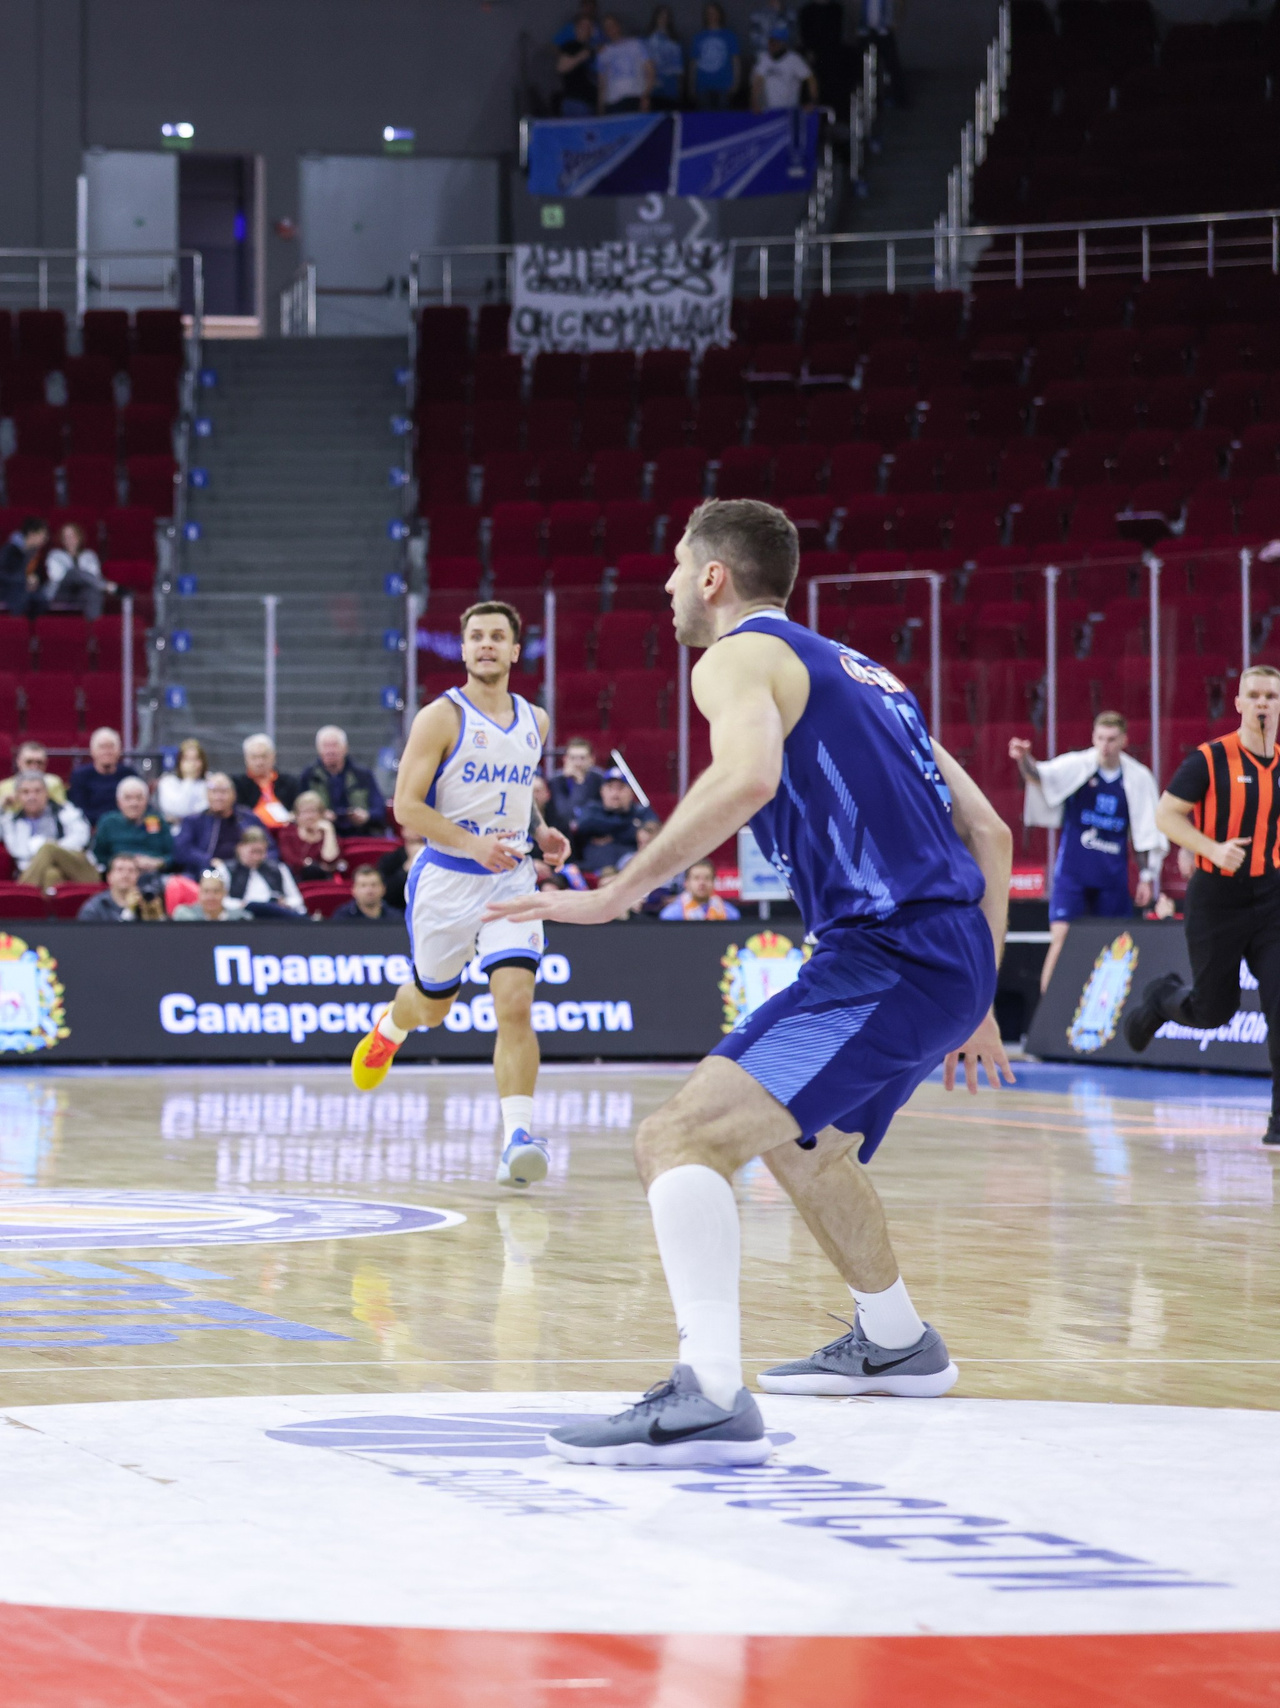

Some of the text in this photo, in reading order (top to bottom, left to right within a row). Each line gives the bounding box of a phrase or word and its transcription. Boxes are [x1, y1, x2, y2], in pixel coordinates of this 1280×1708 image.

[494, 791, 507, 816] 1
[214, 945, 570, 995] Правитео
[443, 995, 634, 1032] обасти
[613, 1464, 1232, 1592] РОССЕТИ
